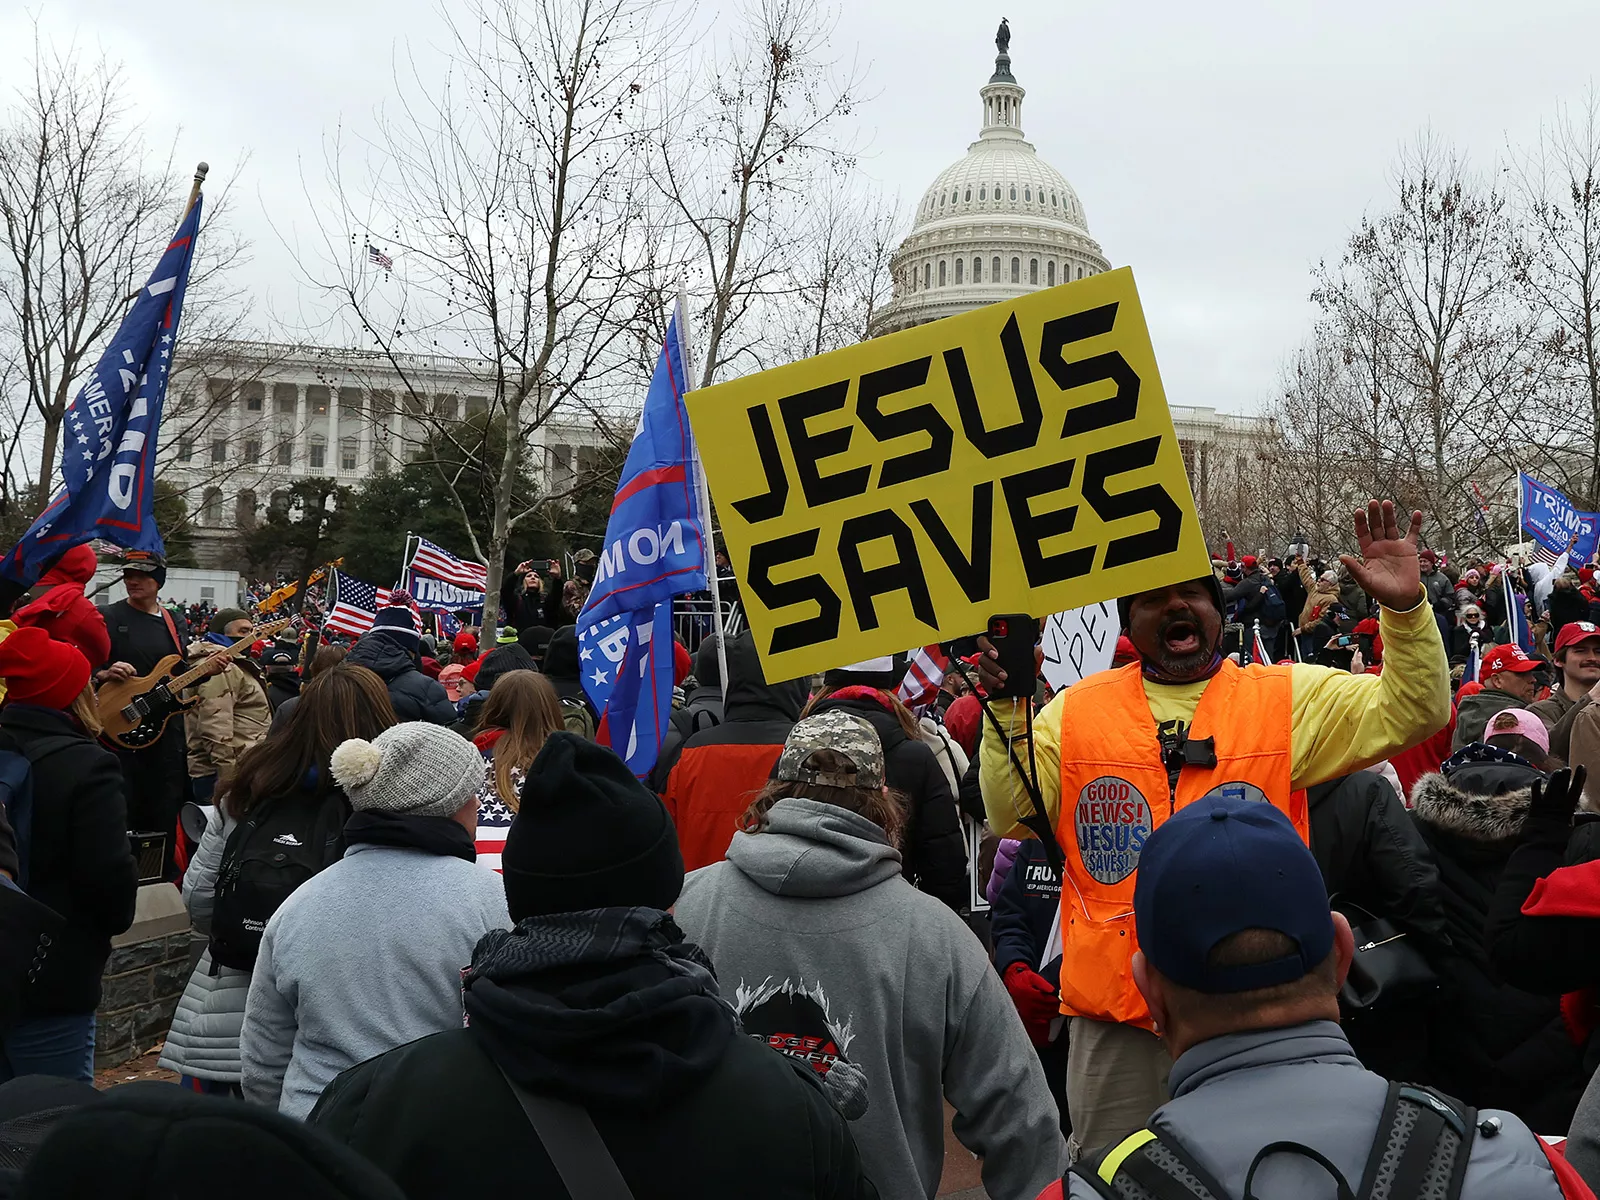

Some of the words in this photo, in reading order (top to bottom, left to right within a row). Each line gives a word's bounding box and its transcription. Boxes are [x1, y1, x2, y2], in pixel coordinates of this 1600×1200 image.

[731, 302, 1141, 524] JESUS
[1534, 489, 1592, 536] TRUMP
[747, 435, 1183, 656] SAVES
[1491, 658, 1503, 670] 45
[1087, 783, 1130, 802] GOOD
[1080, 802, 1144, 824] NEWS!
[1080, 824, 1148, 852] JESUS
[1088, 853, 1130, 872] SAVES!
[1025, 865, 1057, 882] TRU
[242, 917, 264, 927] Johnson
[244, 923, 266, 932] Control
[748, 1033, 818, 1050] ODGE
